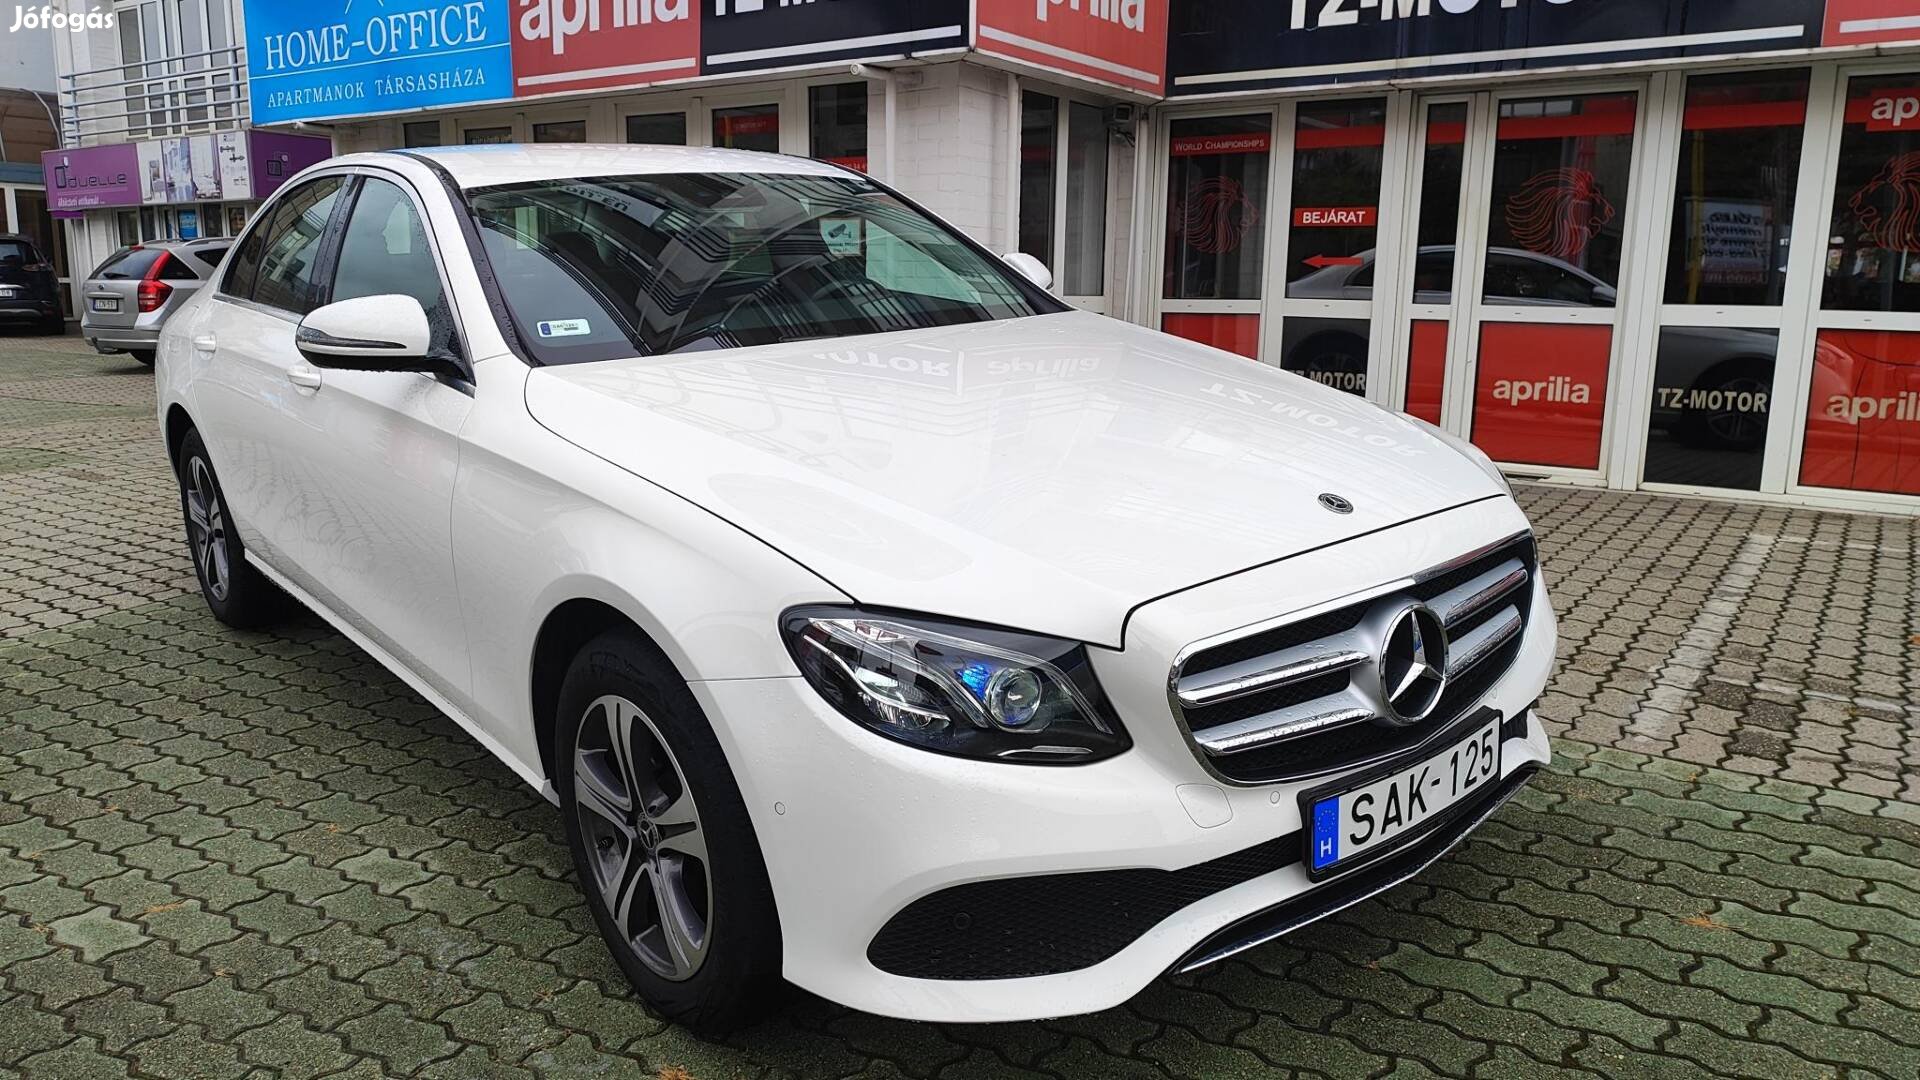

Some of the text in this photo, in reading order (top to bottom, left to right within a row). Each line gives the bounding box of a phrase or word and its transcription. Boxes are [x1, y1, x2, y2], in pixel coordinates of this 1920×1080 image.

[264, 1, 487, 70] HOME-OFFICE
[267, 67, 486, 108] APARTMANOK TÁRSASHÁZA
[1303, 208, 1366, 224] BEJÁRAT
[1288, 369, 1366, 391] MOTOR
[1492, 375, 1590, 406] aprilia
[1657, 387, 1768, 413] TZ-MOTOR
[1349, 727, 1494, 846] SAK-125
[1320, 837, 1332, 858] H
